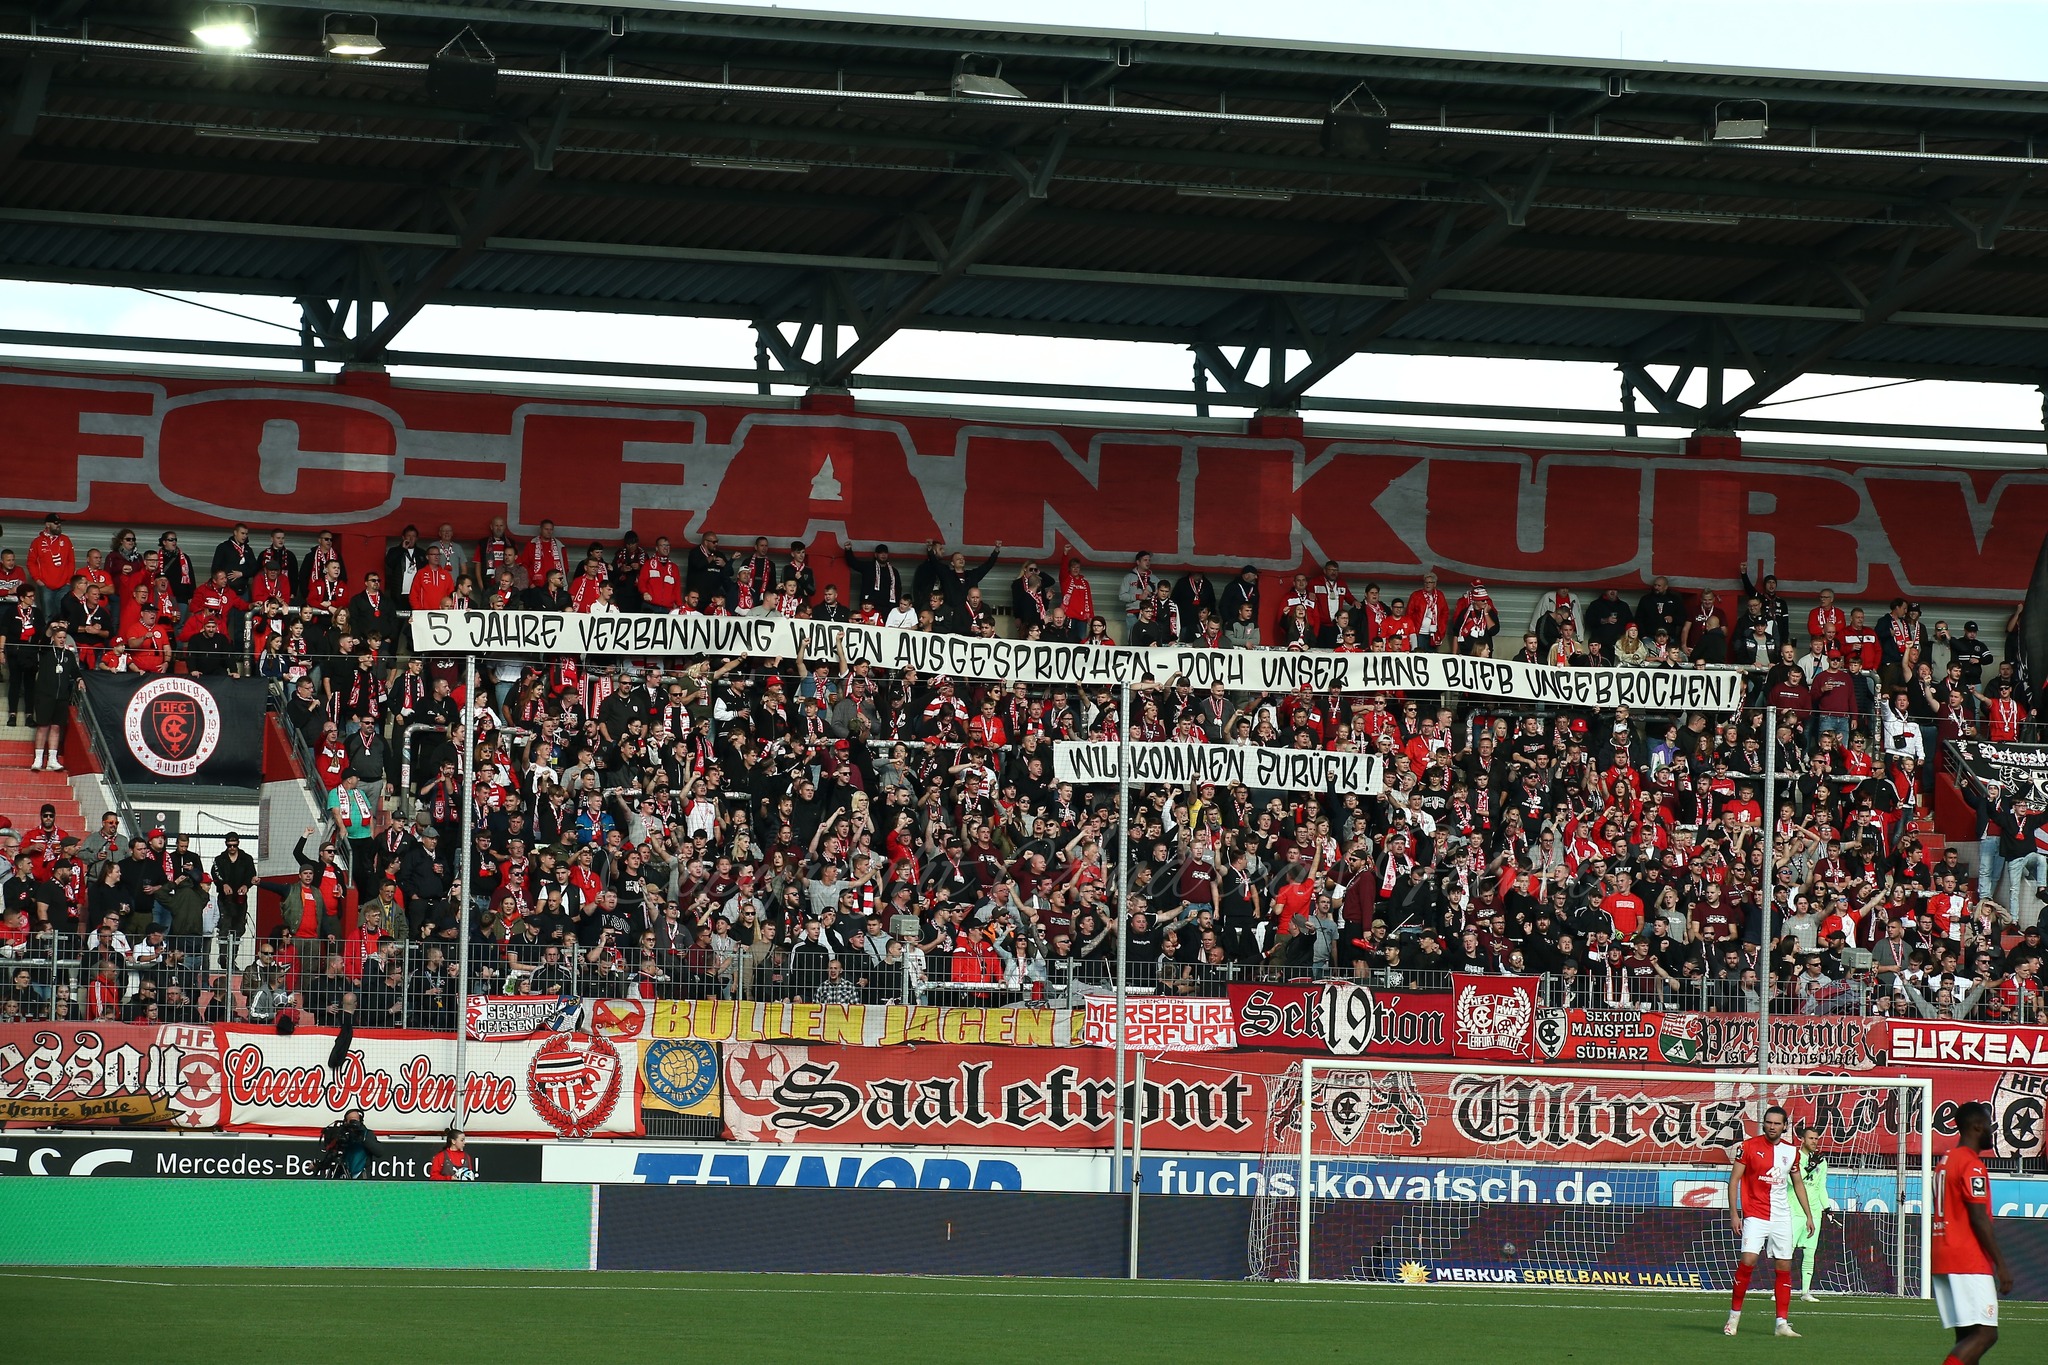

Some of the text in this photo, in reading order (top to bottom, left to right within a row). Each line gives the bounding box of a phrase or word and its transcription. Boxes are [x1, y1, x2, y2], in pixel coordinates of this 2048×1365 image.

[428, 613, 452, 646] 5
[466, 612, 564, 648] JAHRE
[579, 617, 774, 652] VERBANNUNG
[895, 631, 1152, 685] AUSGESPROCHEN
[1261, 655, 1350, 688] UNSER
[1362, 655, 1430, 687] HANS
[1447, 657, 1513, 694] BLIEB
[135, 679, 210, 705] Merseburger
[160, 703, 187, 713] HFC
[129, 717, 138, 728] 19
[208, 718, 217, 729] 19
[129, 731, 140, 742] 66
[205, 732, 216, 743] 66
[154, 760, 195, 774] Jungs
[1471, 996, 1490, 1005] HFC
[1502, 999, 1515, 1007] FC
[486, 1003, 556, 1020] SEKTION
[1496, 1005, 1518, 1015] RWE
[1586, 1011, 1641, 1022] SEKTION
[652, 1000, 864, 1044] BULLEN
[881, 1005, 1056, 1047] JAGEN
[1571, 1023, 1655, 1038] MANSFELD
[1697, 1016, 1861, 1062] Pyrmanie
[1892, 1028, 2048, 1065] SURREAL
[1576, 1042, 1648, 1060] SÜDHARZ
[1753, 1047, 1859, 1067] eidenschaft
[581, 1053, 608, 1067] HFC
[225, 1044, 516, 1129] Coesa Per Sempre
[1333, 1073, 1366, 1087] HFC
[772, 1060, 1253, 1131] Saalefront
[1449, 1074, 1748, 1149] Ultras
[1436, 1268, 1700, 1287] MERKUR SPIELBANK HALLE
